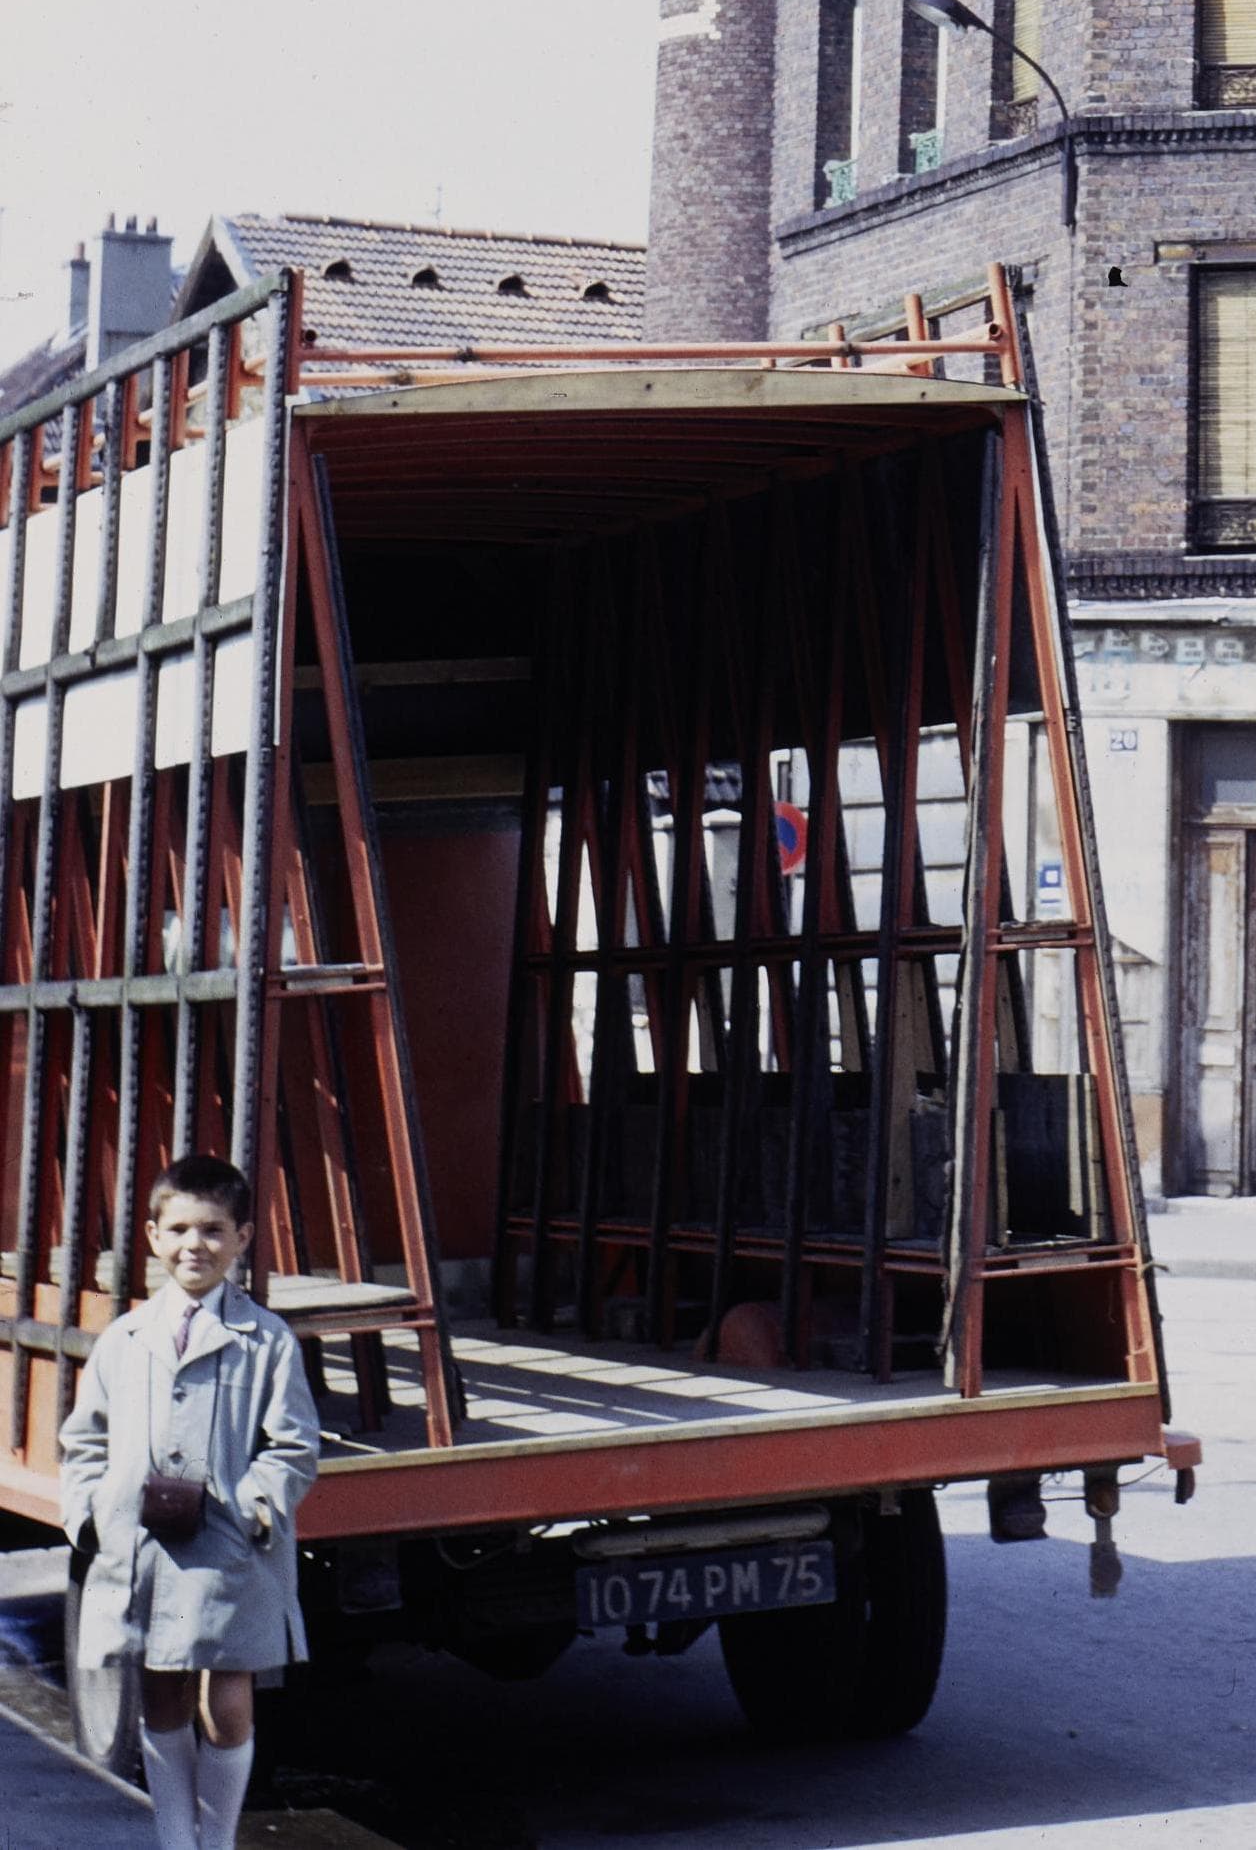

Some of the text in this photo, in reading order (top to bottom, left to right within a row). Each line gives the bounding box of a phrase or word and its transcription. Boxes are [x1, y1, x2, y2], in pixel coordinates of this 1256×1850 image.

[1111, 729, 1137, 751] 20
[588, 1553, 823, 1623] 1074 PM 75
